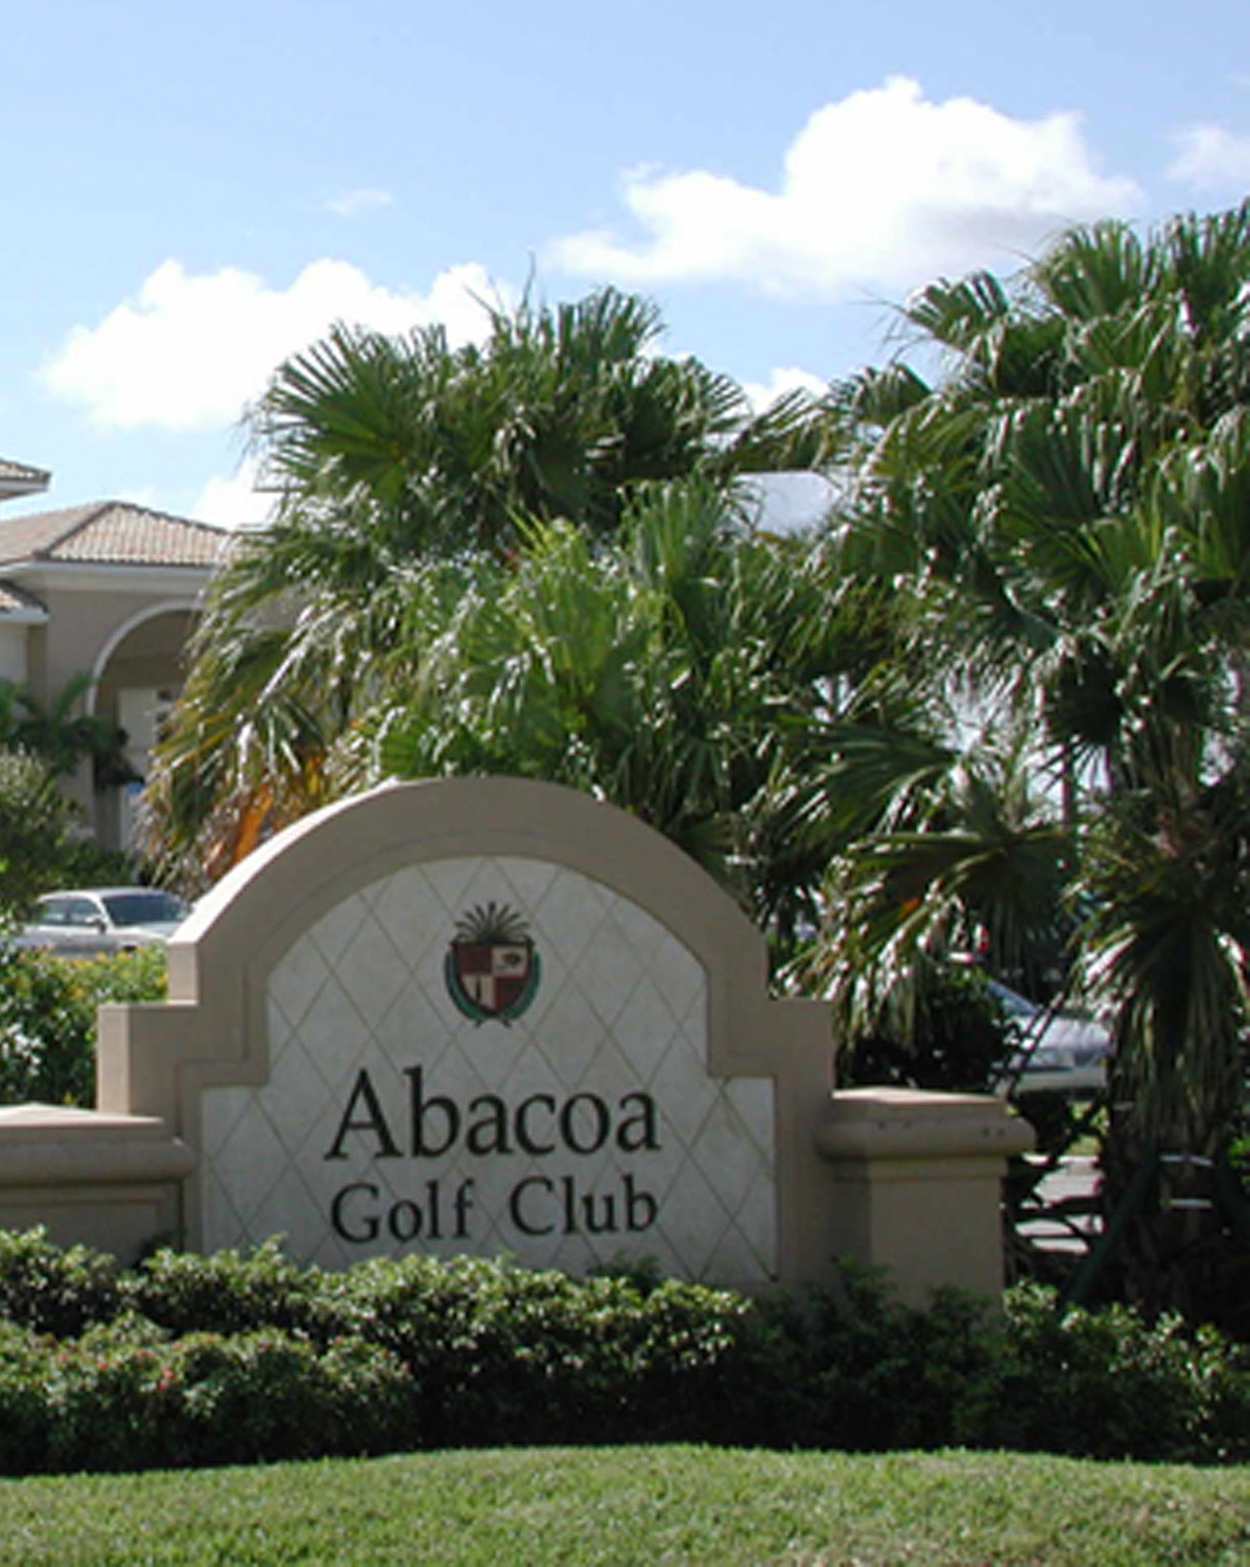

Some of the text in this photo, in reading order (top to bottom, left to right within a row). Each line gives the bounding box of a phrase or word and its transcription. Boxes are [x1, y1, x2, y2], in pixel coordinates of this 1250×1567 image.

[324, 1064, 662, 1161] Abacoa
[330, 1173, 659, 1244] Golf Club
